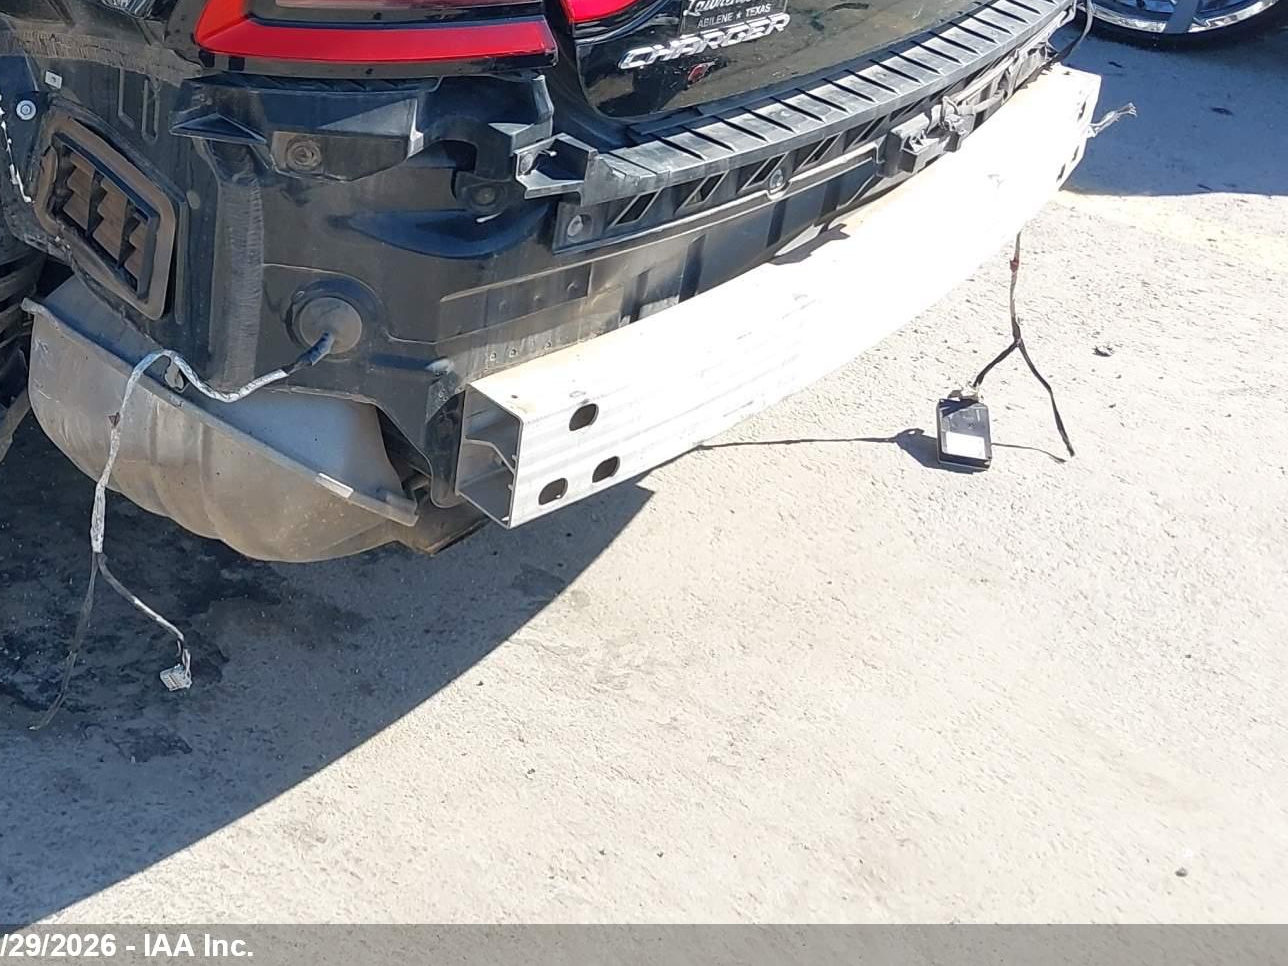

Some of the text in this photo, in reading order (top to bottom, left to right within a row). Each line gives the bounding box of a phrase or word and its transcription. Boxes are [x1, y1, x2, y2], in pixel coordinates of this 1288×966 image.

[697, 2, 772, 29] ABILENE TEXAS
[618, 12, 791, 70] CHARGER
